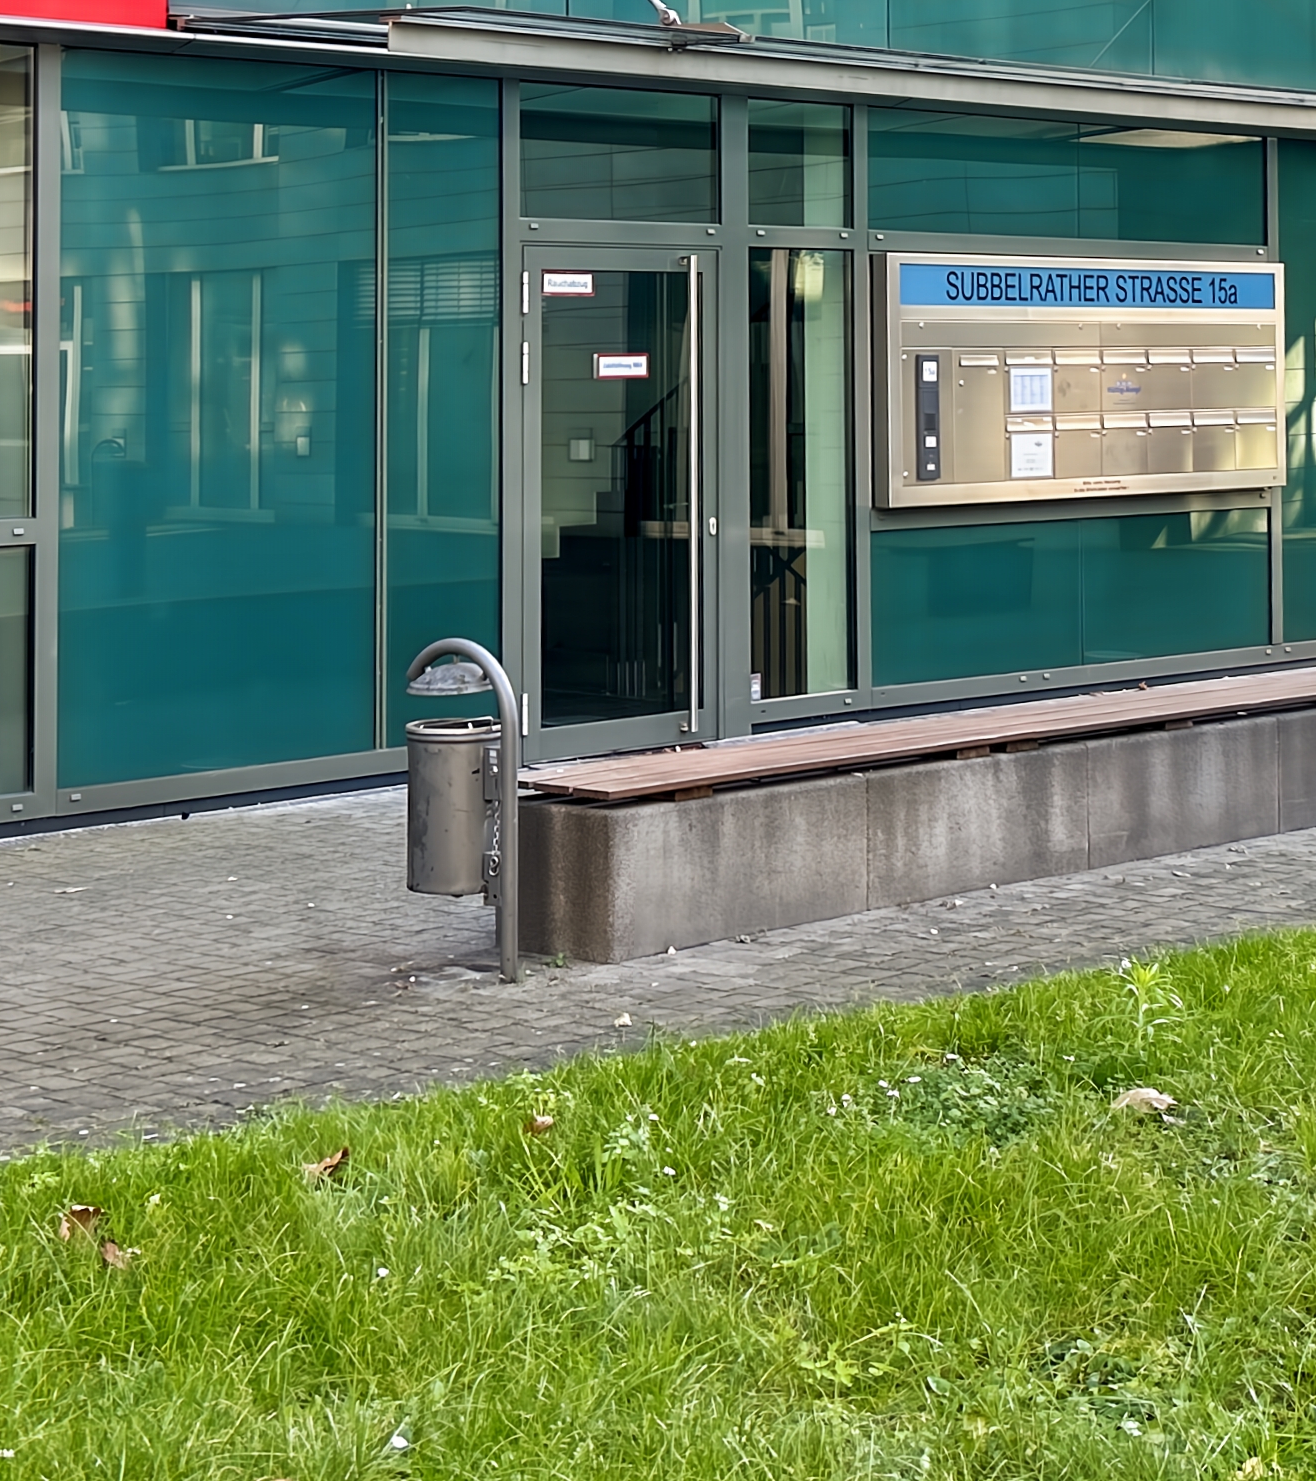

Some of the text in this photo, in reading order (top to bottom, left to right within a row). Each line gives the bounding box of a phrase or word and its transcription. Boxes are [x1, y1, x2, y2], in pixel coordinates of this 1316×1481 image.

[946, 271, 1238, 305] SUBBELRATHER STRASSE 15a
